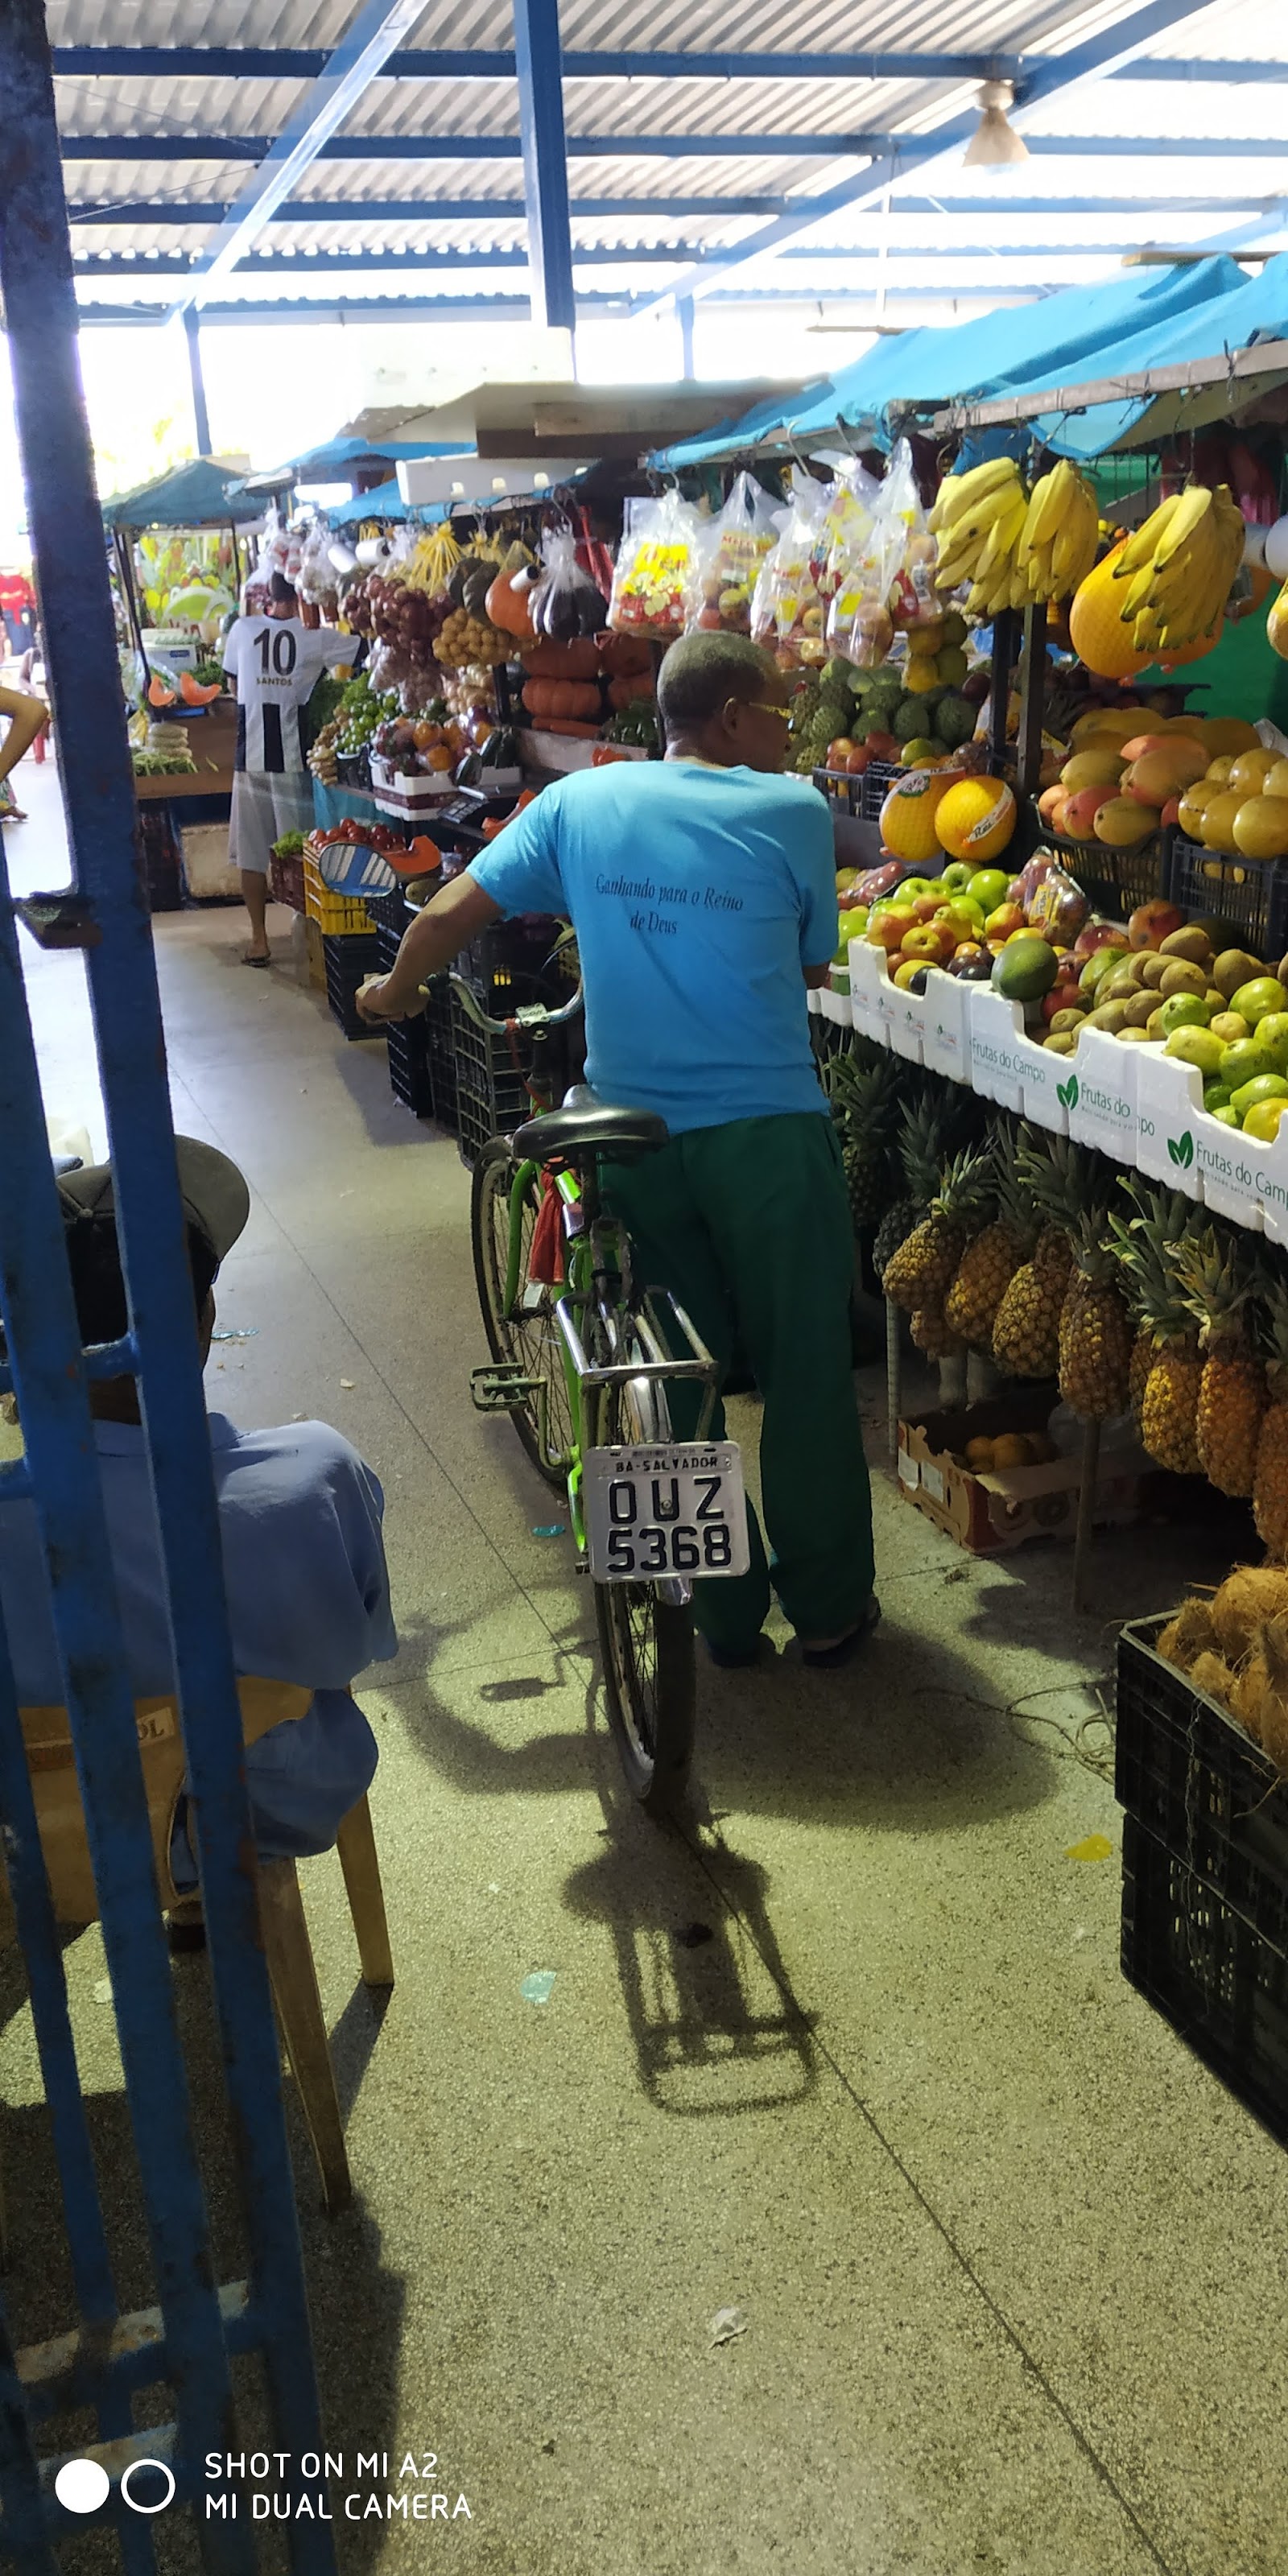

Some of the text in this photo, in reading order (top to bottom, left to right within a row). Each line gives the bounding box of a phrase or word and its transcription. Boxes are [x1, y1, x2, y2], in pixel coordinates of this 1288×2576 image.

[254, 628, 296, 676] 10
[256, 677, 293, 687] SANTOS
[596, 873, 744, 911] Ganhando para o Reino
[630, 910, 678, 935] de Deus
[970, 1037, 998, 1064] Frutas
[999, 1049, 1012, 1069] do
[1013, 1054, 1046, 1084] Campo
[1080, 1082, 1131, 1118] Frutas do
[1196, 1140, 1288, 1211] Frutas do Cam
[615, 1456, 719, 1472] BA-SALVADOR
[609, 1476, 724, 1524] OUZ
[607, 1524, 732, 1573] 5368
